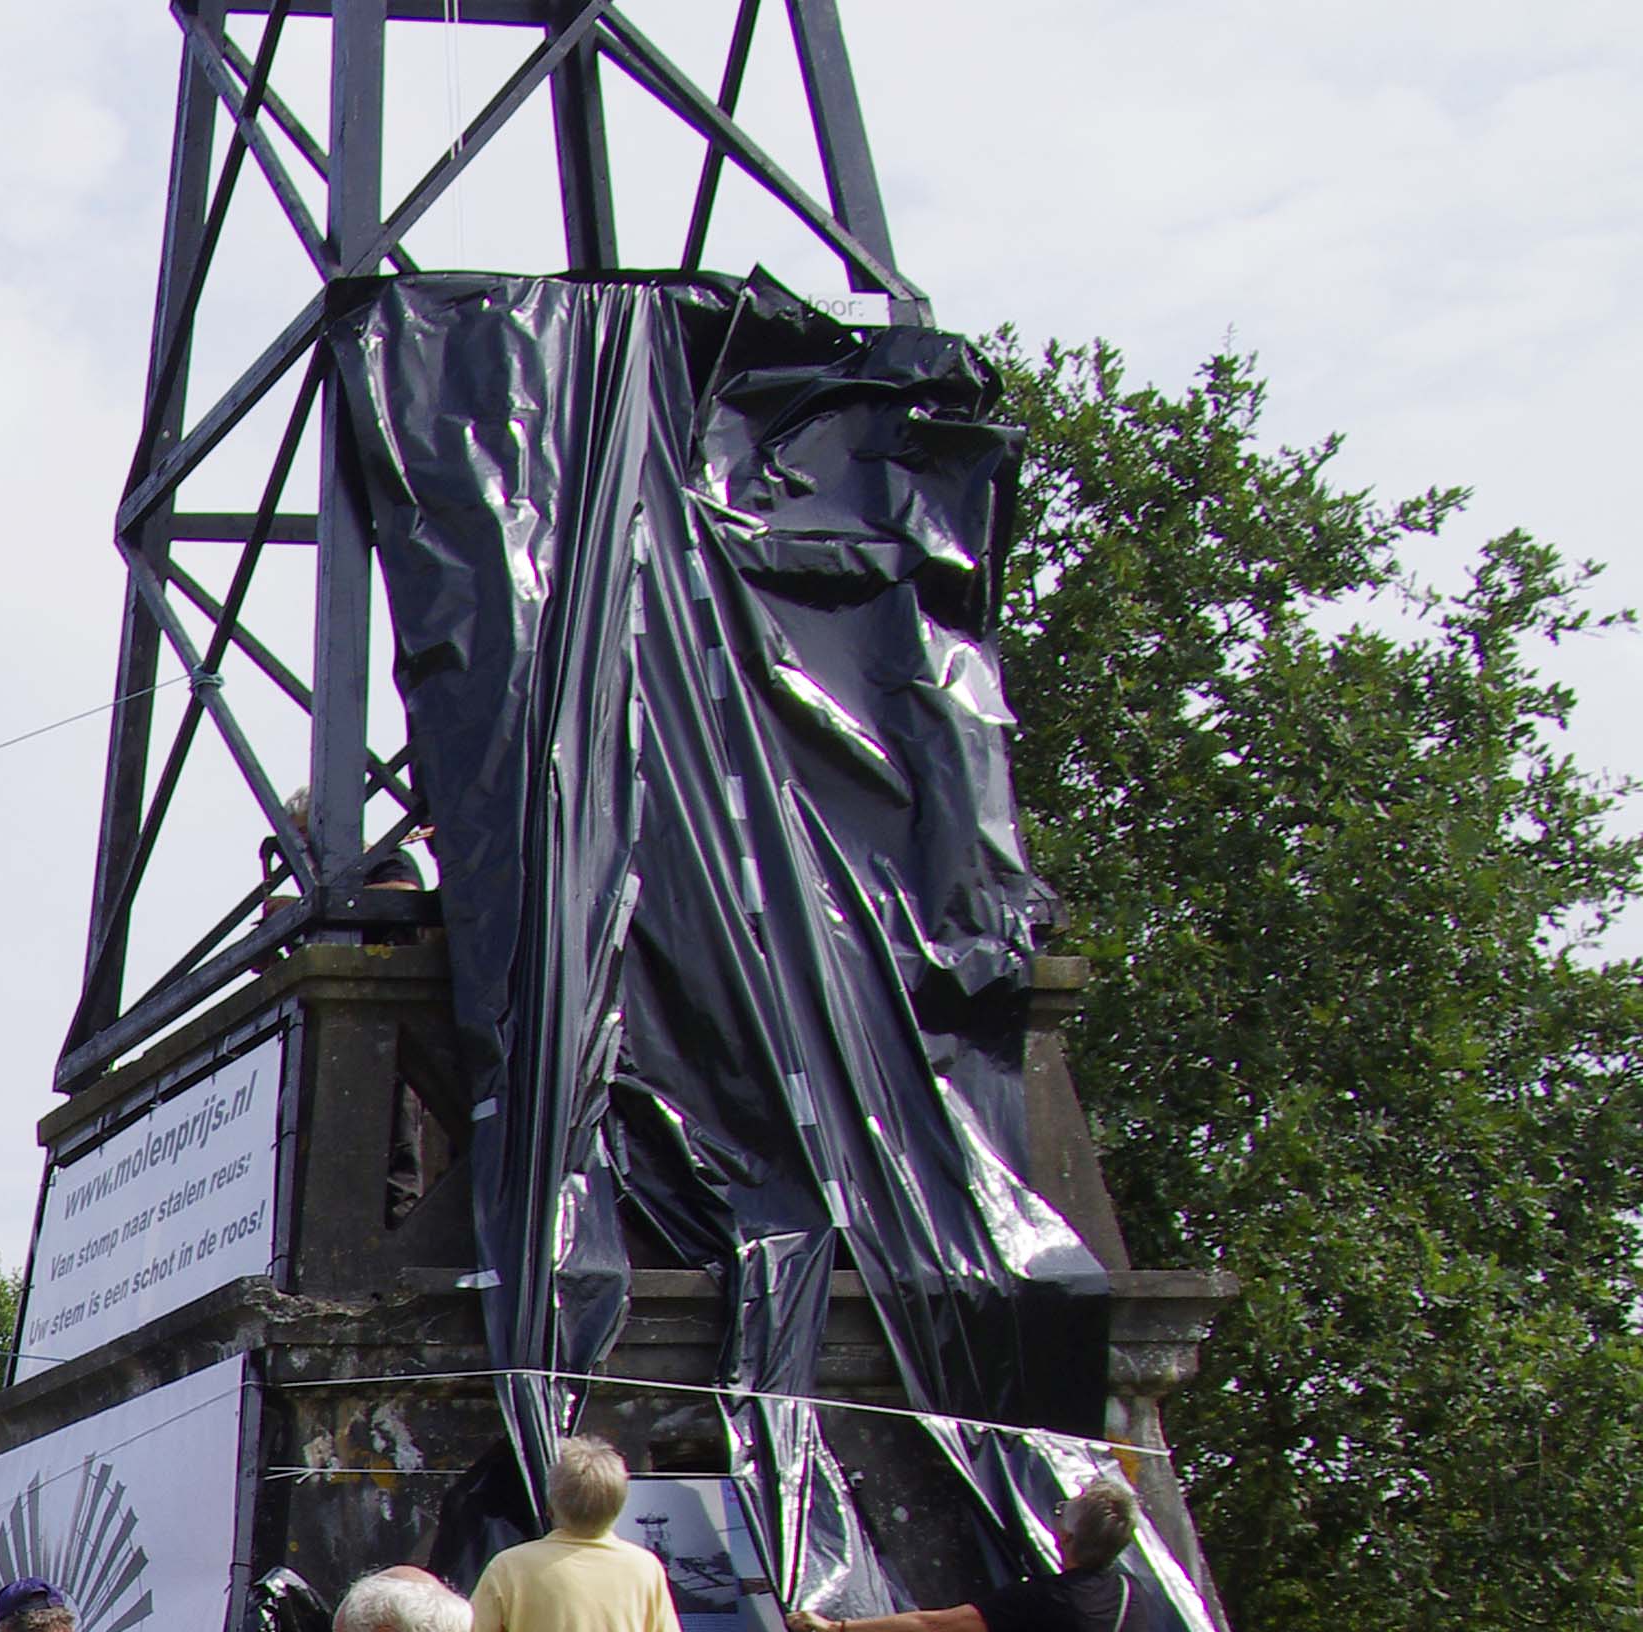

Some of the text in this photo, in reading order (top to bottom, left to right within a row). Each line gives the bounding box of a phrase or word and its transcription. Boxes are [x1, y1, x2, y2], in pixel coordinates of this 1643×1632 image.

[51, 1152, 252, 1281] Van stomp naar stalen reus:
[64, 1070, 258, 1220] www.molenprijs.nl
[28, 1199, 266, 1346] Uw stem is een schot in de roos!
